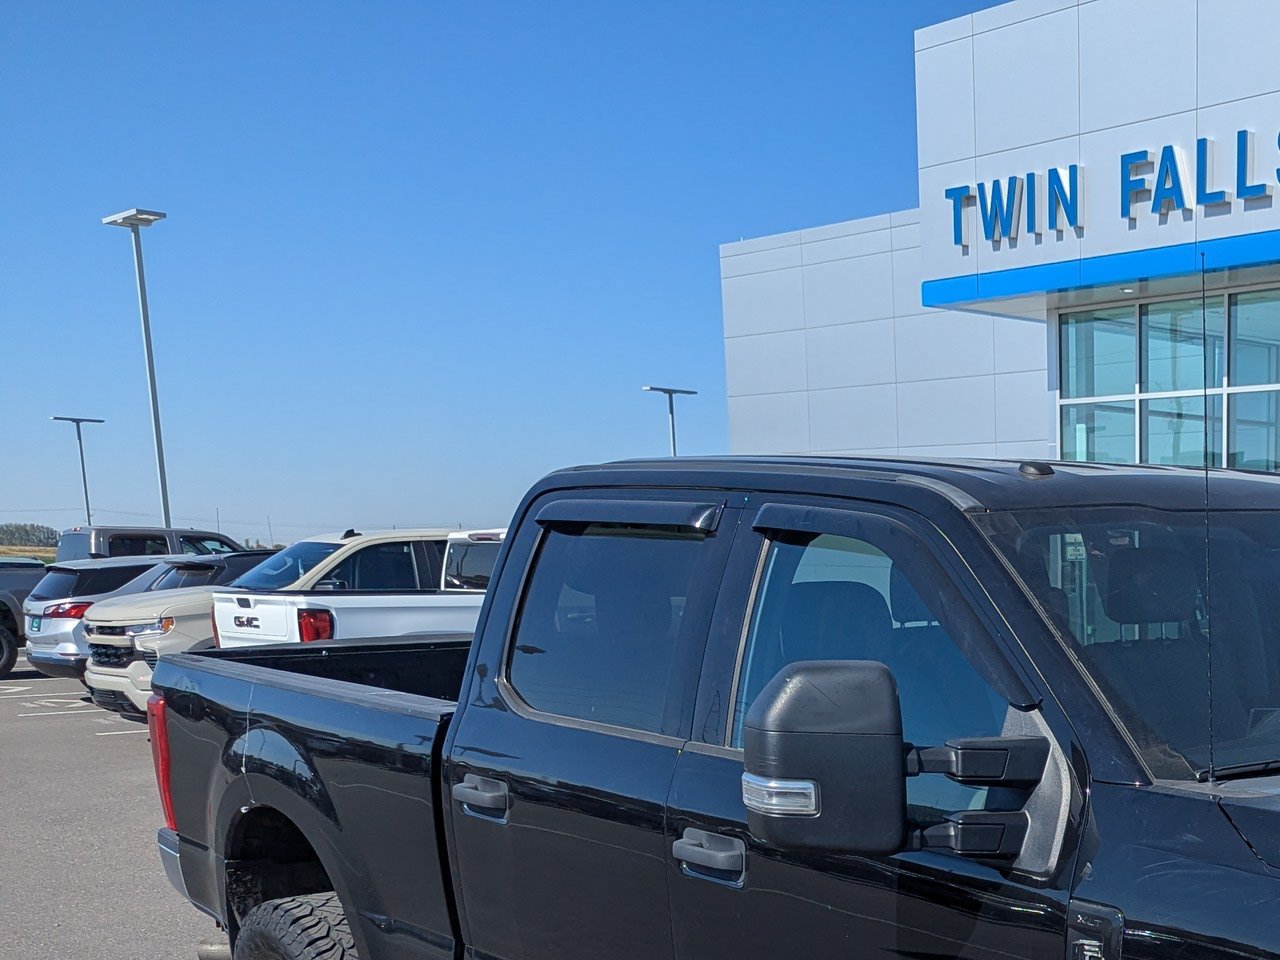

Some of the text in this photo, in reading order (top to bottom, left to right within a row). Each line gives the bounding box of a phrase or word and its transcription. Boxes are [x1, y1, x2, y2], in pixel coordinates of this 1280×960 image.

[945, 164, 1084, 247] TWIN
[233, 616, 260, 629] GMC
[1076, 914, 1103, 927] XLT
